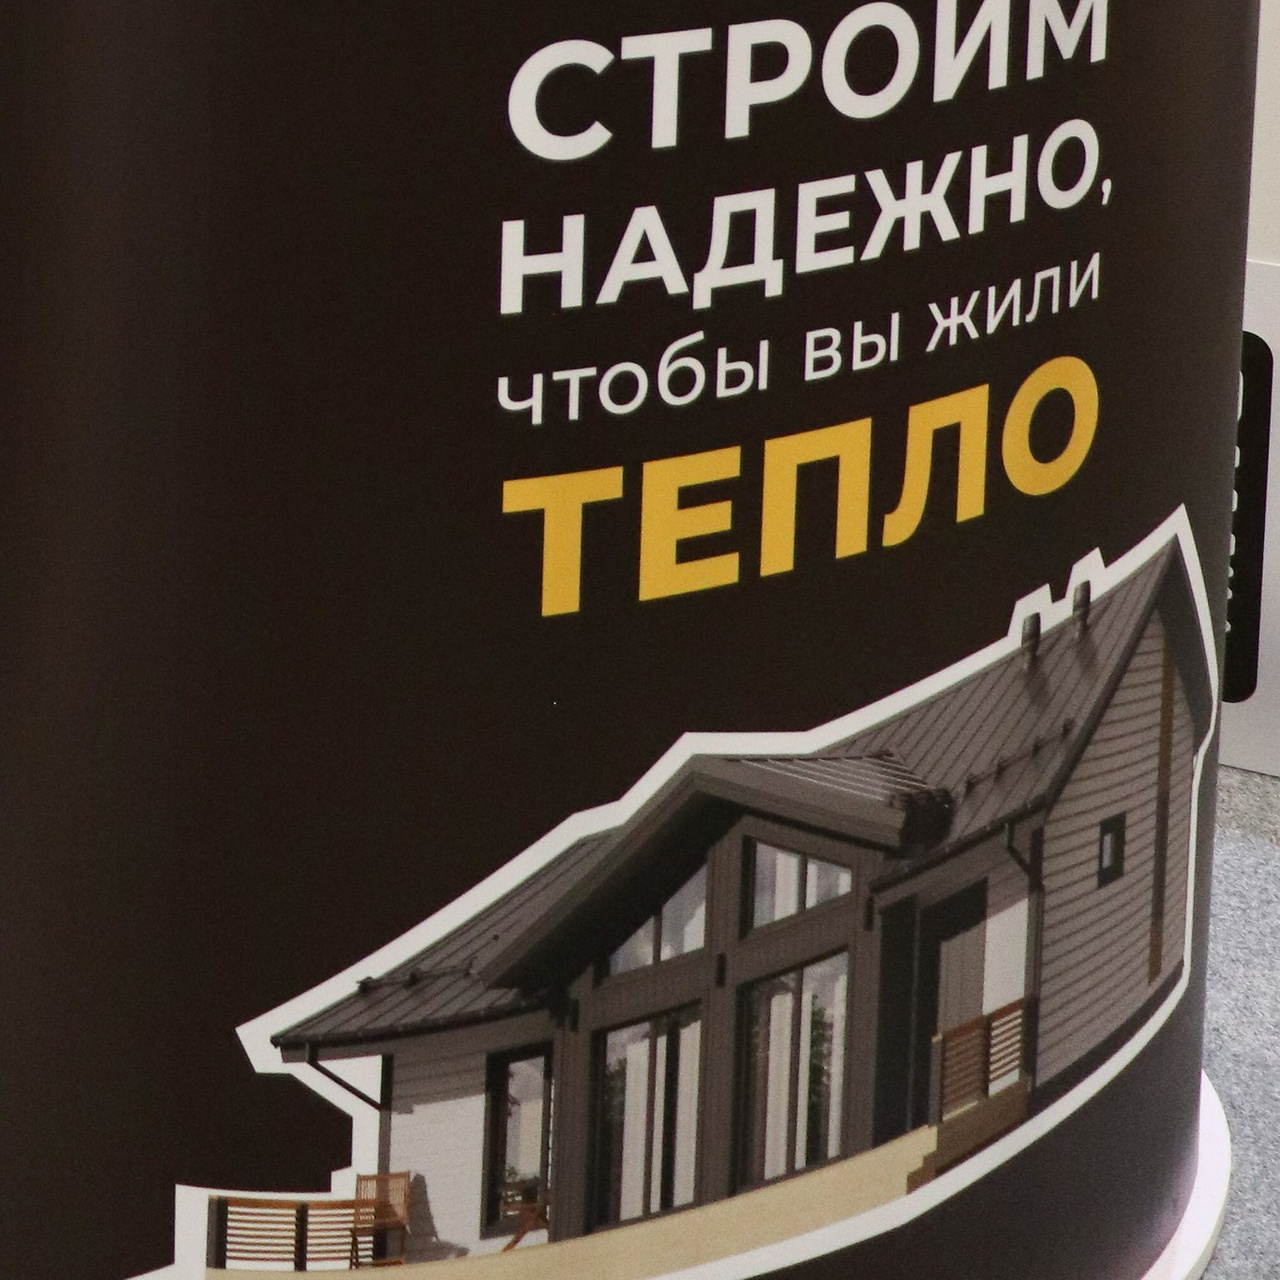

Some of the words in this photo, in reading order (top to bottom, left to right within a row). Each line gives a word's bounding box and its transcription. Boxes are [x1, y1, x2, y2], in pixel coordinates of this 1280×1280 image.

[498, 117, 1114, 315] НАДЕЖНО,
[496, 330, 770, 426] чтобы
[803, 311, 901, 383] вы
[925, 251, 1102, 353] жили
[501, 355, 1100, 618] ТЕПЛО
